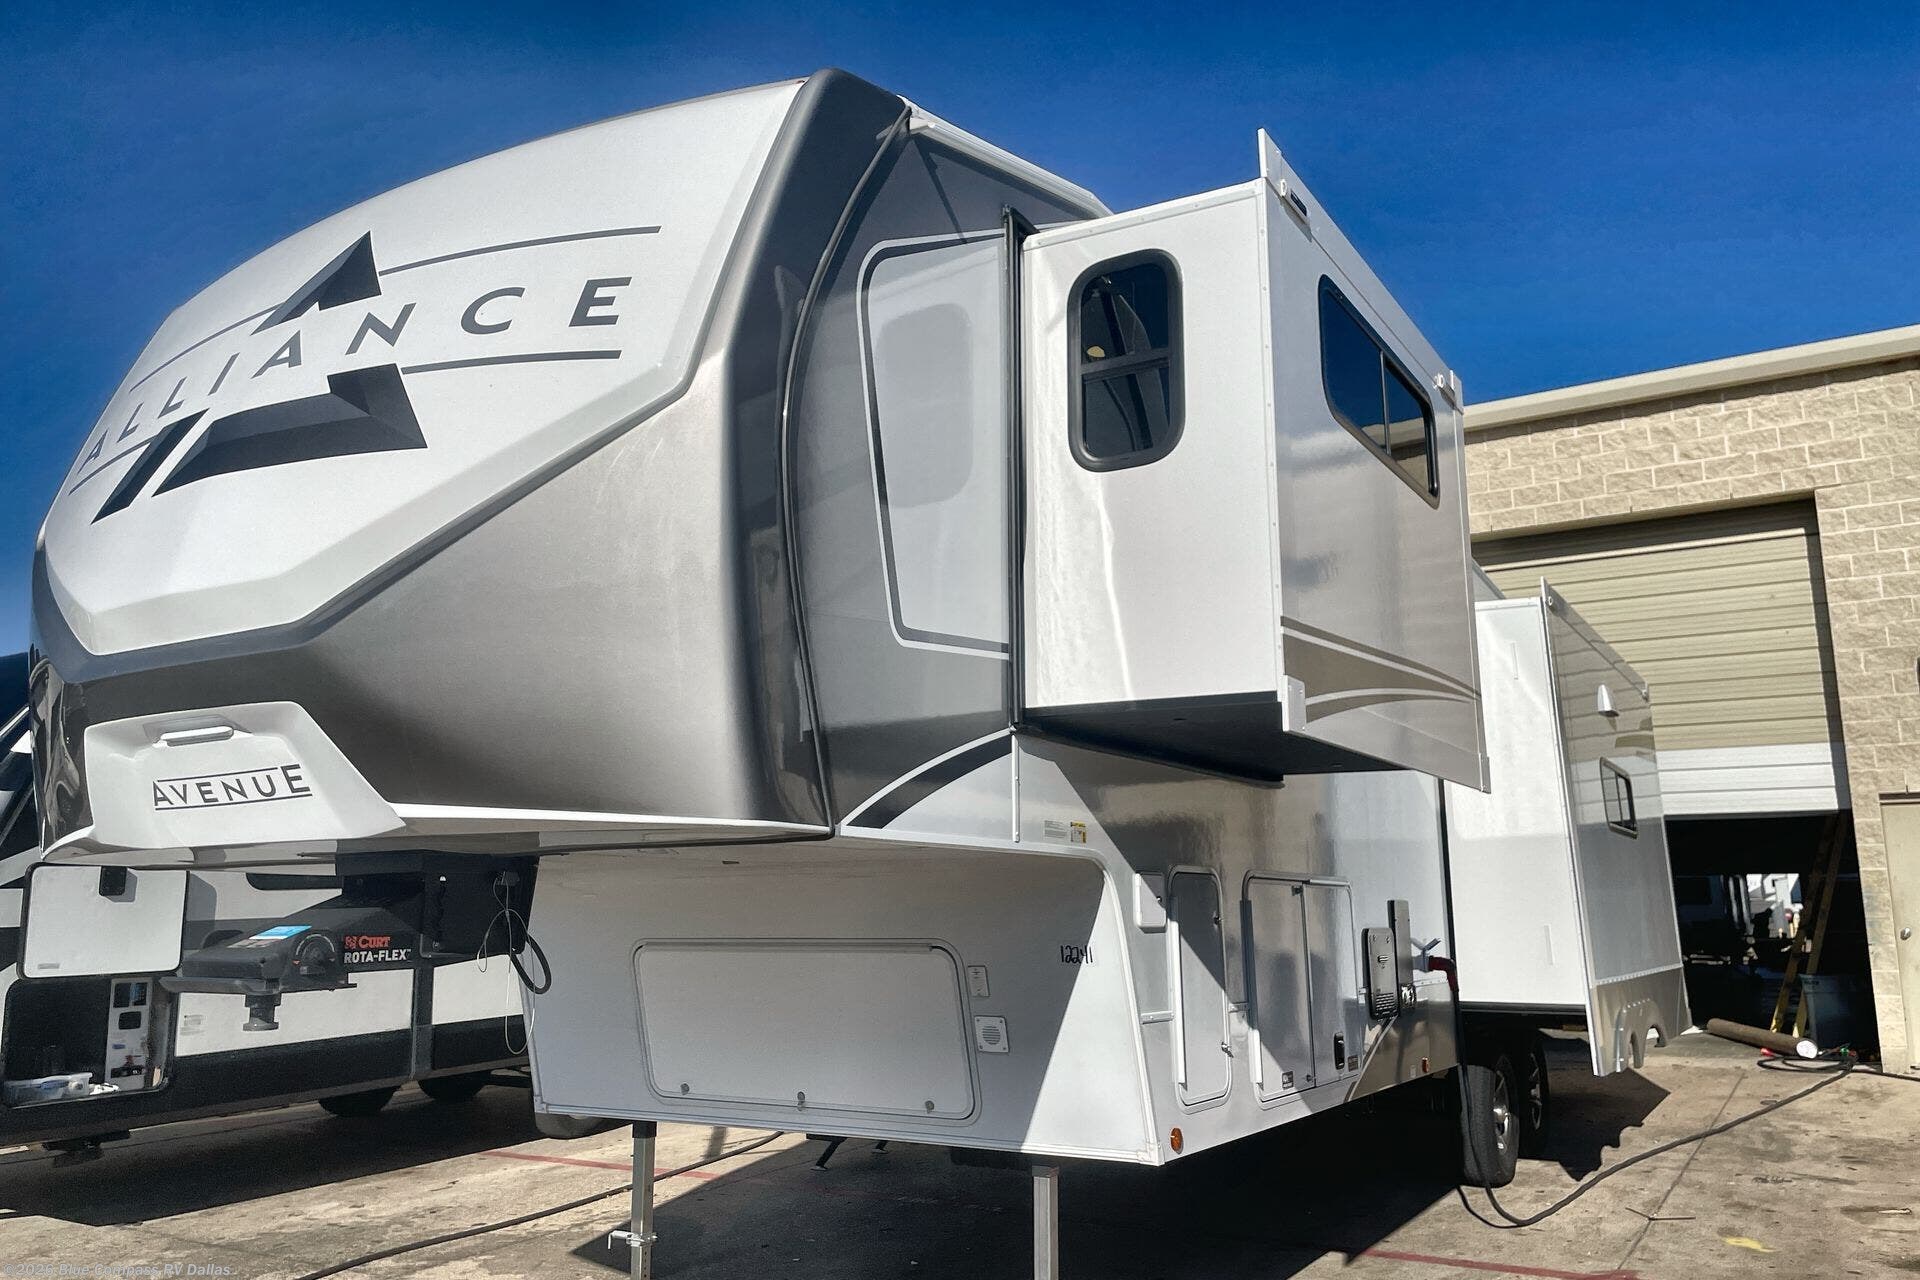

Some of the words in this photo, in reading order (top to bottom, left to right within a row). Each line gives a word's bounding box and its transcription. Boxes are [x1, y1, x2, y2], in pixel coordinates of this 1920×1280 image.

[77, 276, 633, 477] ALLIANCE
[153, 764, 311, 807] AVENUE
[358, 935, 391, 949] CURT
[1060, 945, 1093, 964] 12241
